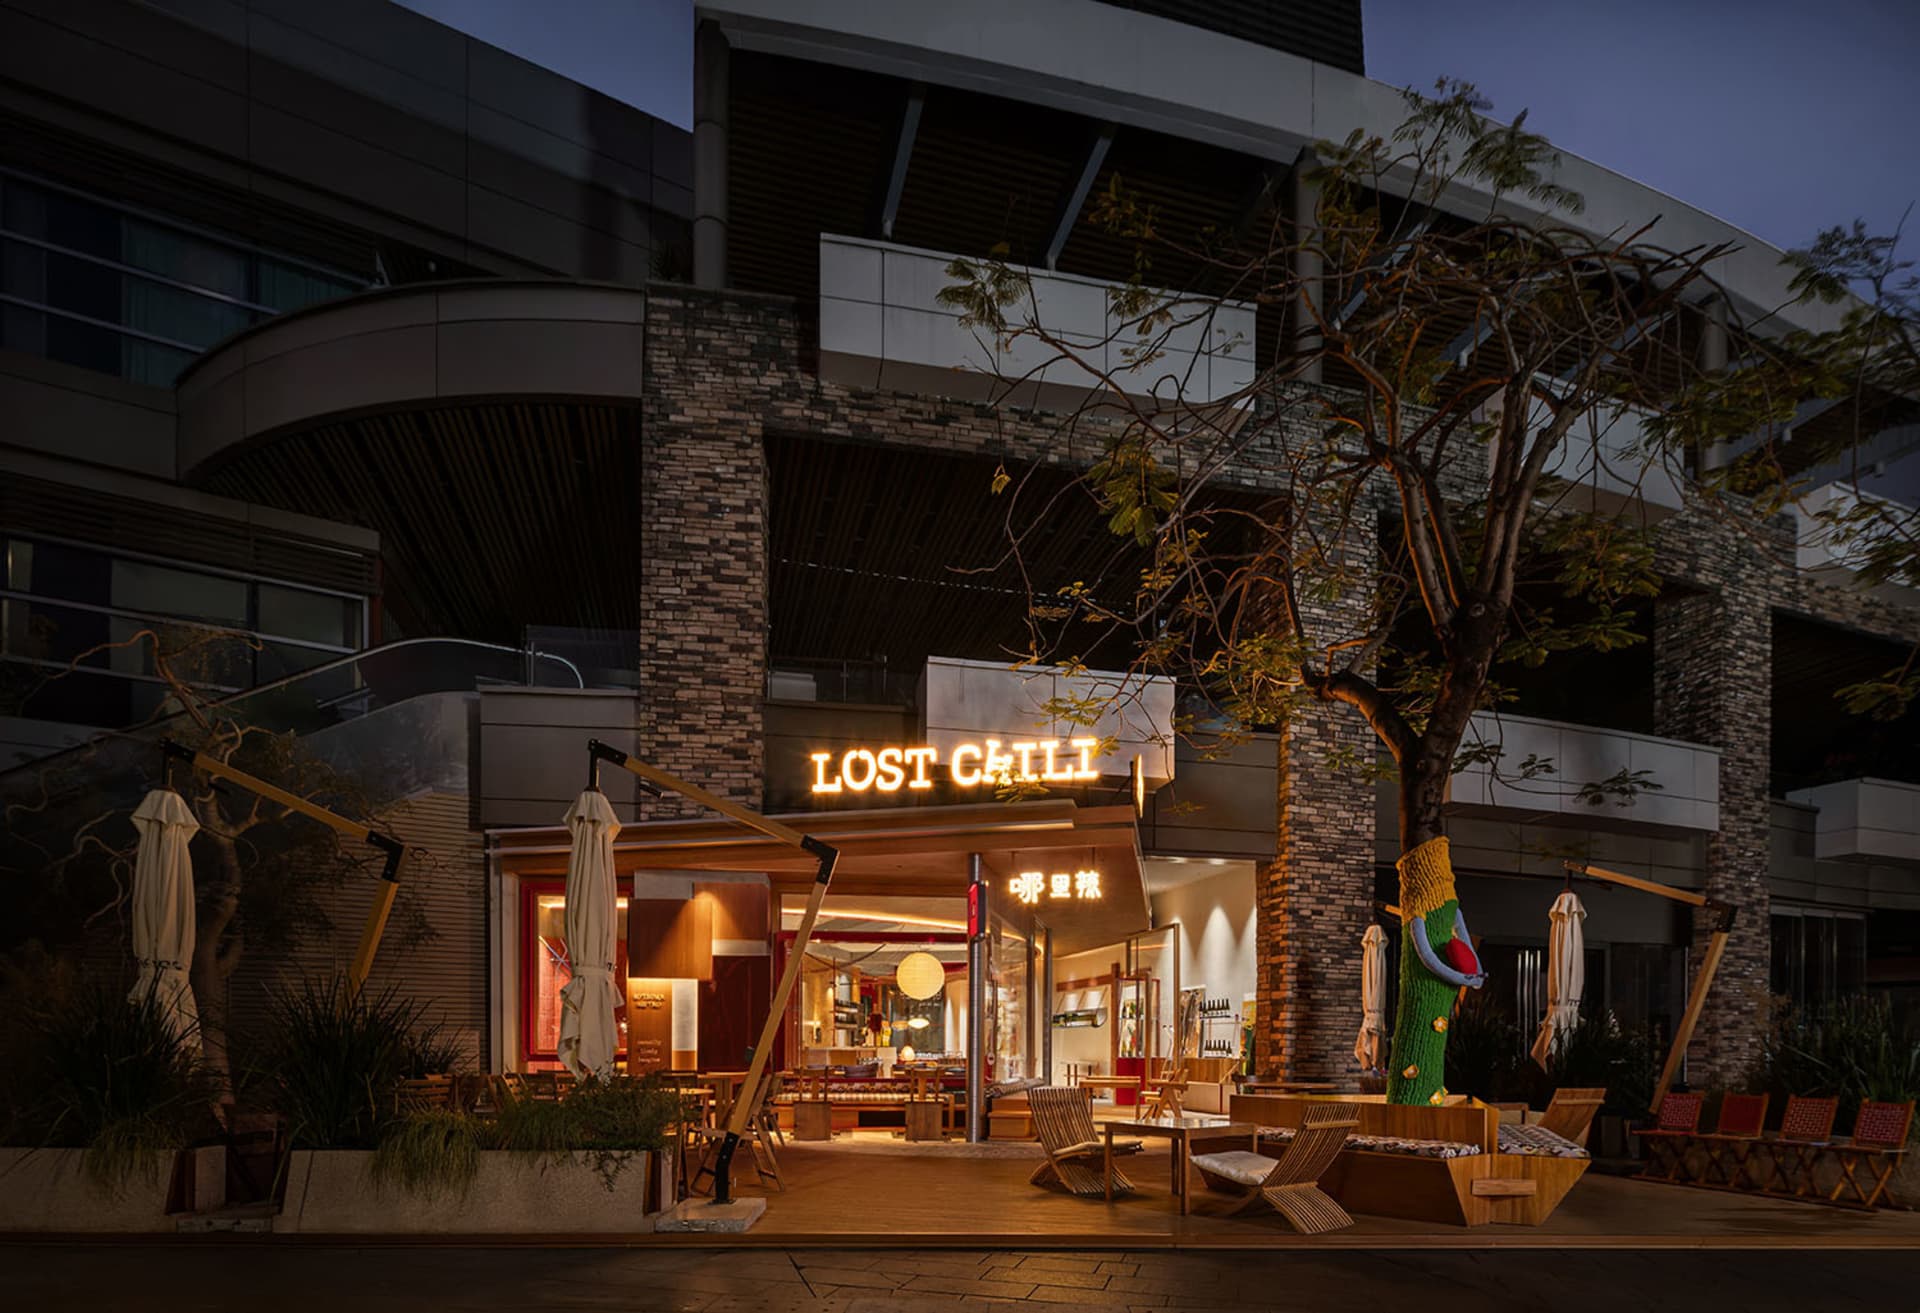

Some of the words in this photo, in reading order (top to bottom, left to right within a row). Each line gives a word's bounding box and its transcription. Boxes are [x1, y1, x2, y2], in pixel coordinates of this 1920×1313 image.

[811, 748, 937, 792] LOST
[1009, 870, 1102, 904] 哪里辣
